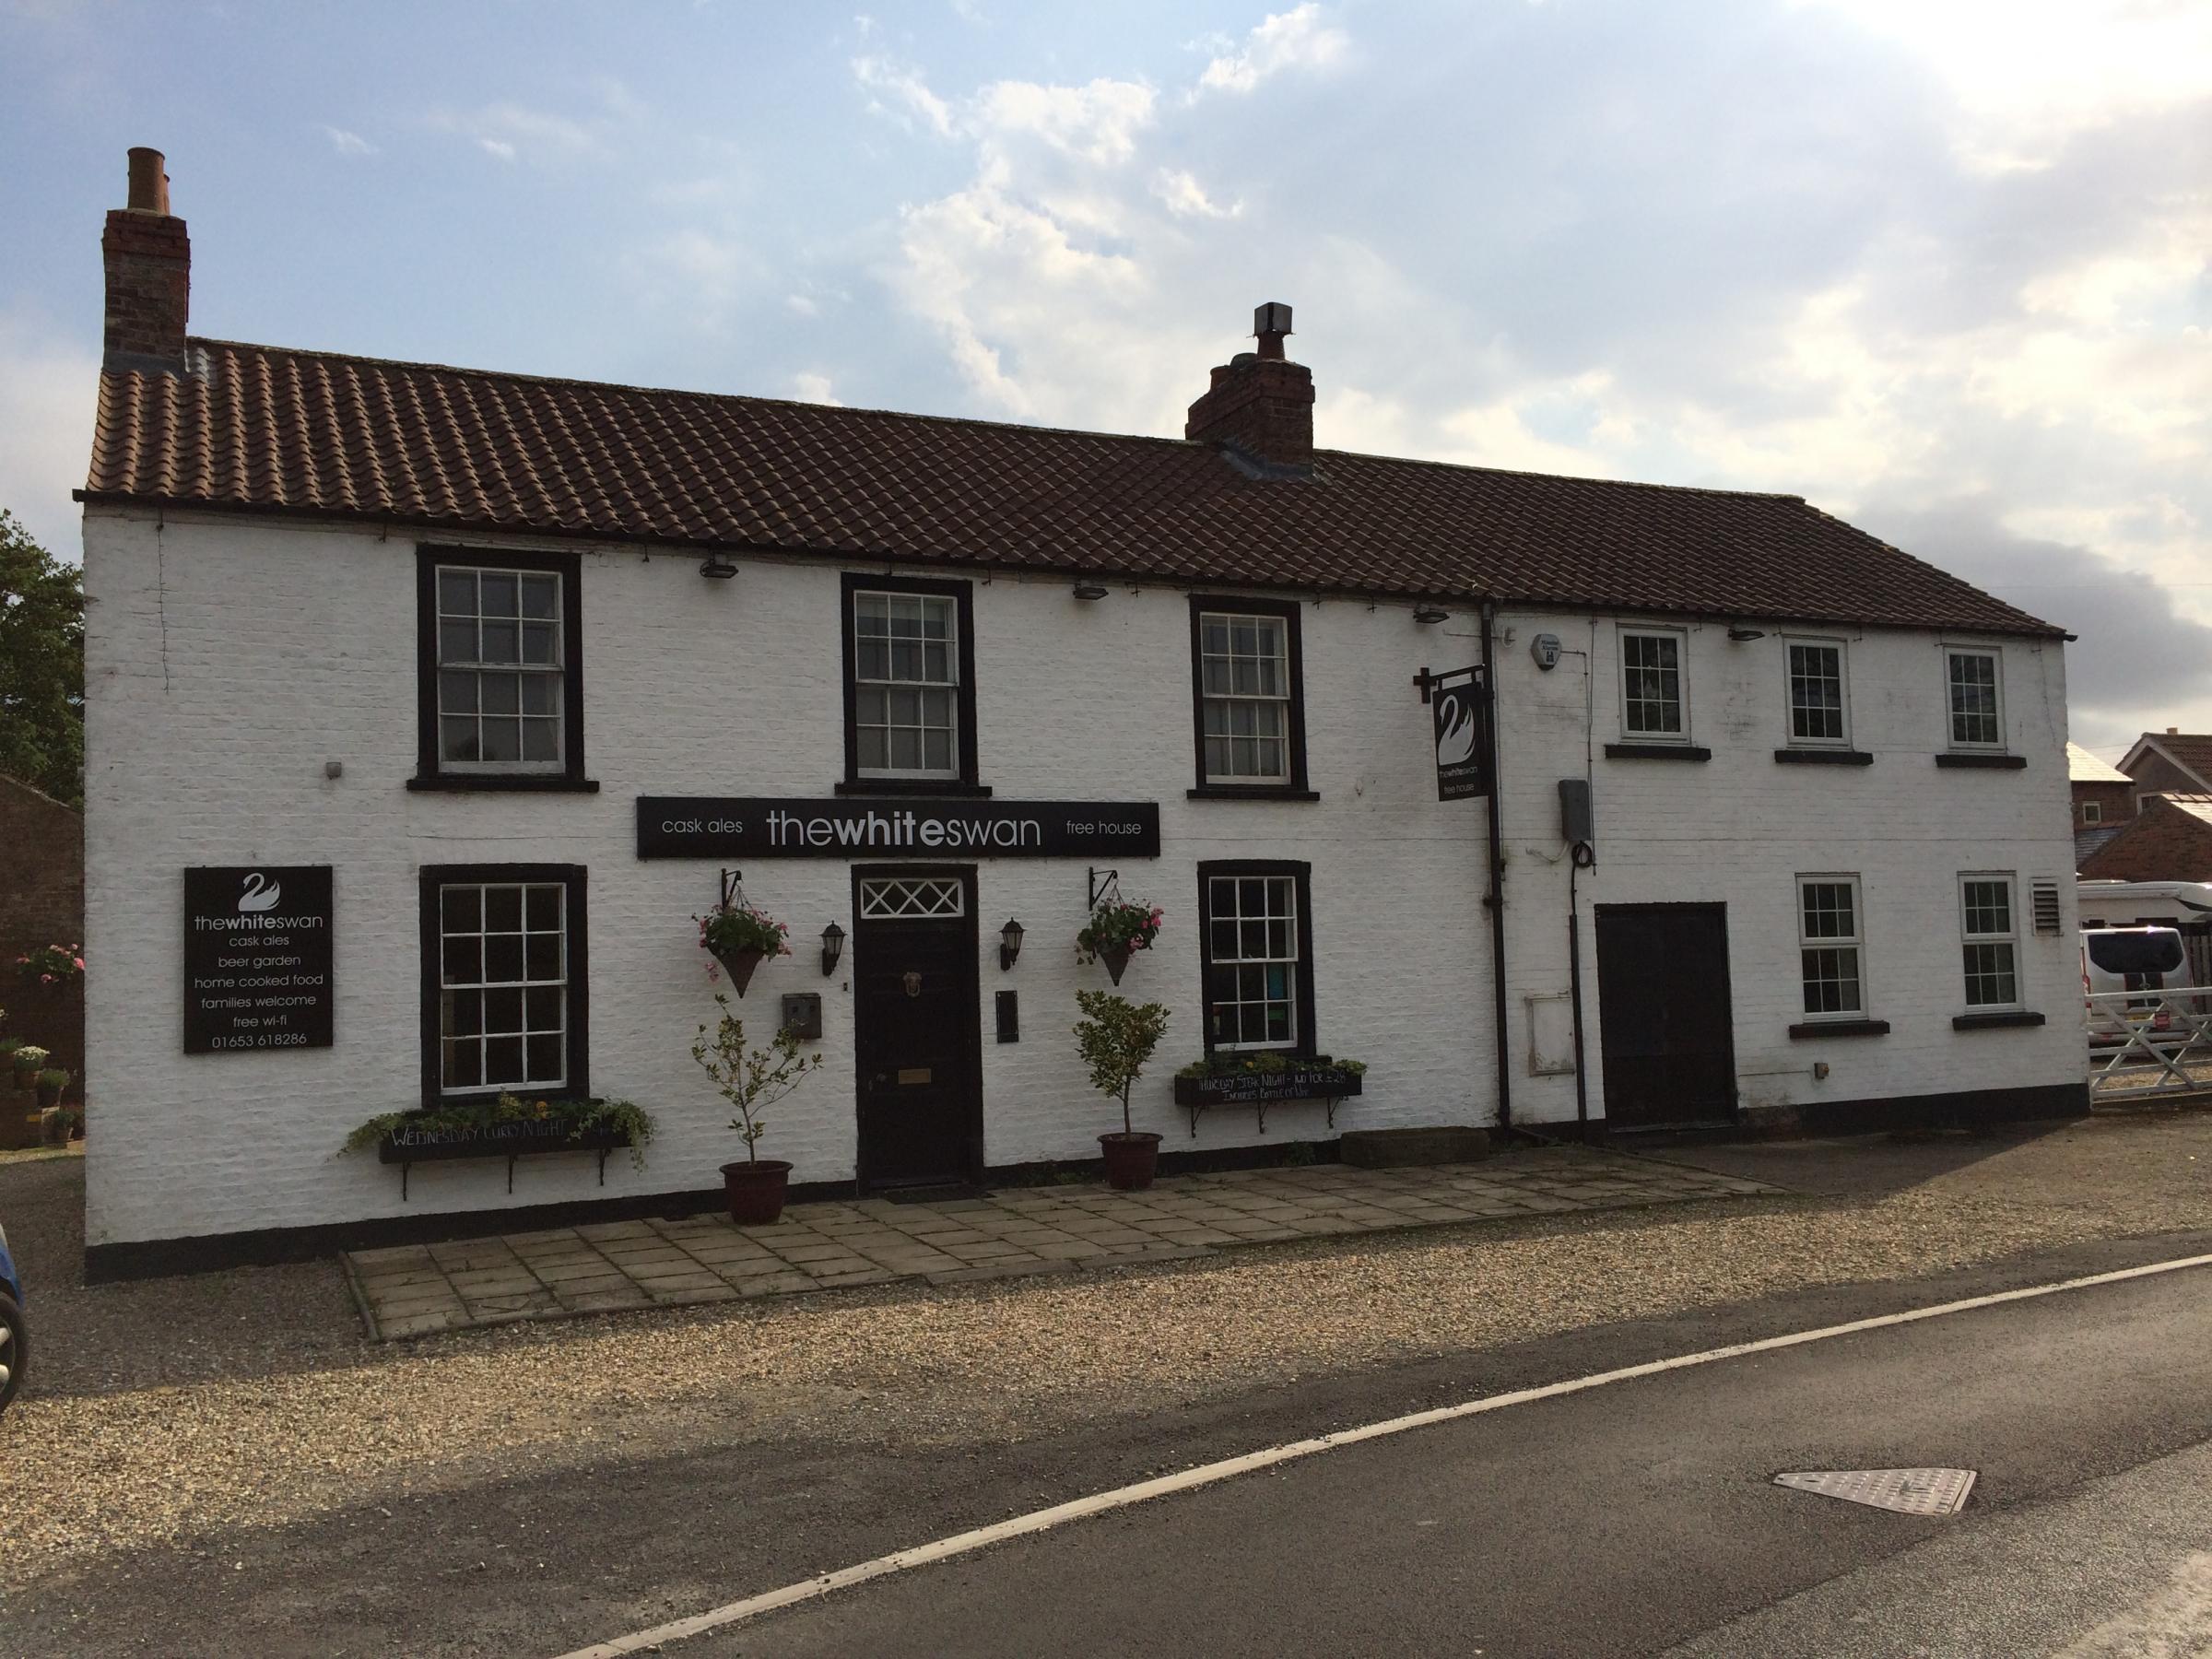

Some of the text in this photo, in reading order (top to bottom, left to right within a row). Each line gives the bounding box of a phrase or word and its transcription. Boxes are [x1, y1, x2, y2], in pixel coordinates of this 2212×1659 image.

[662, 818, 744, 833] cask ales
[766, 810, 1041, 846] thewhiteswan
[1066, 819, 1142, 834] free house
[194, 914, 323, 930] thewhiteswan
[229, 935, 289, 947] cask ales
[218, 955, 301, 969] beer garden
[194, 974, 324, 989] home cooked food
[201, 995, 317, 1009] families welcome
[233, 1015, 288, 1028] free wi-fi
[212, 1033, 307, 1049] 01653 618286
[391, 1119, 568, 1147] WEDNESDAY CURRY NIGHT
